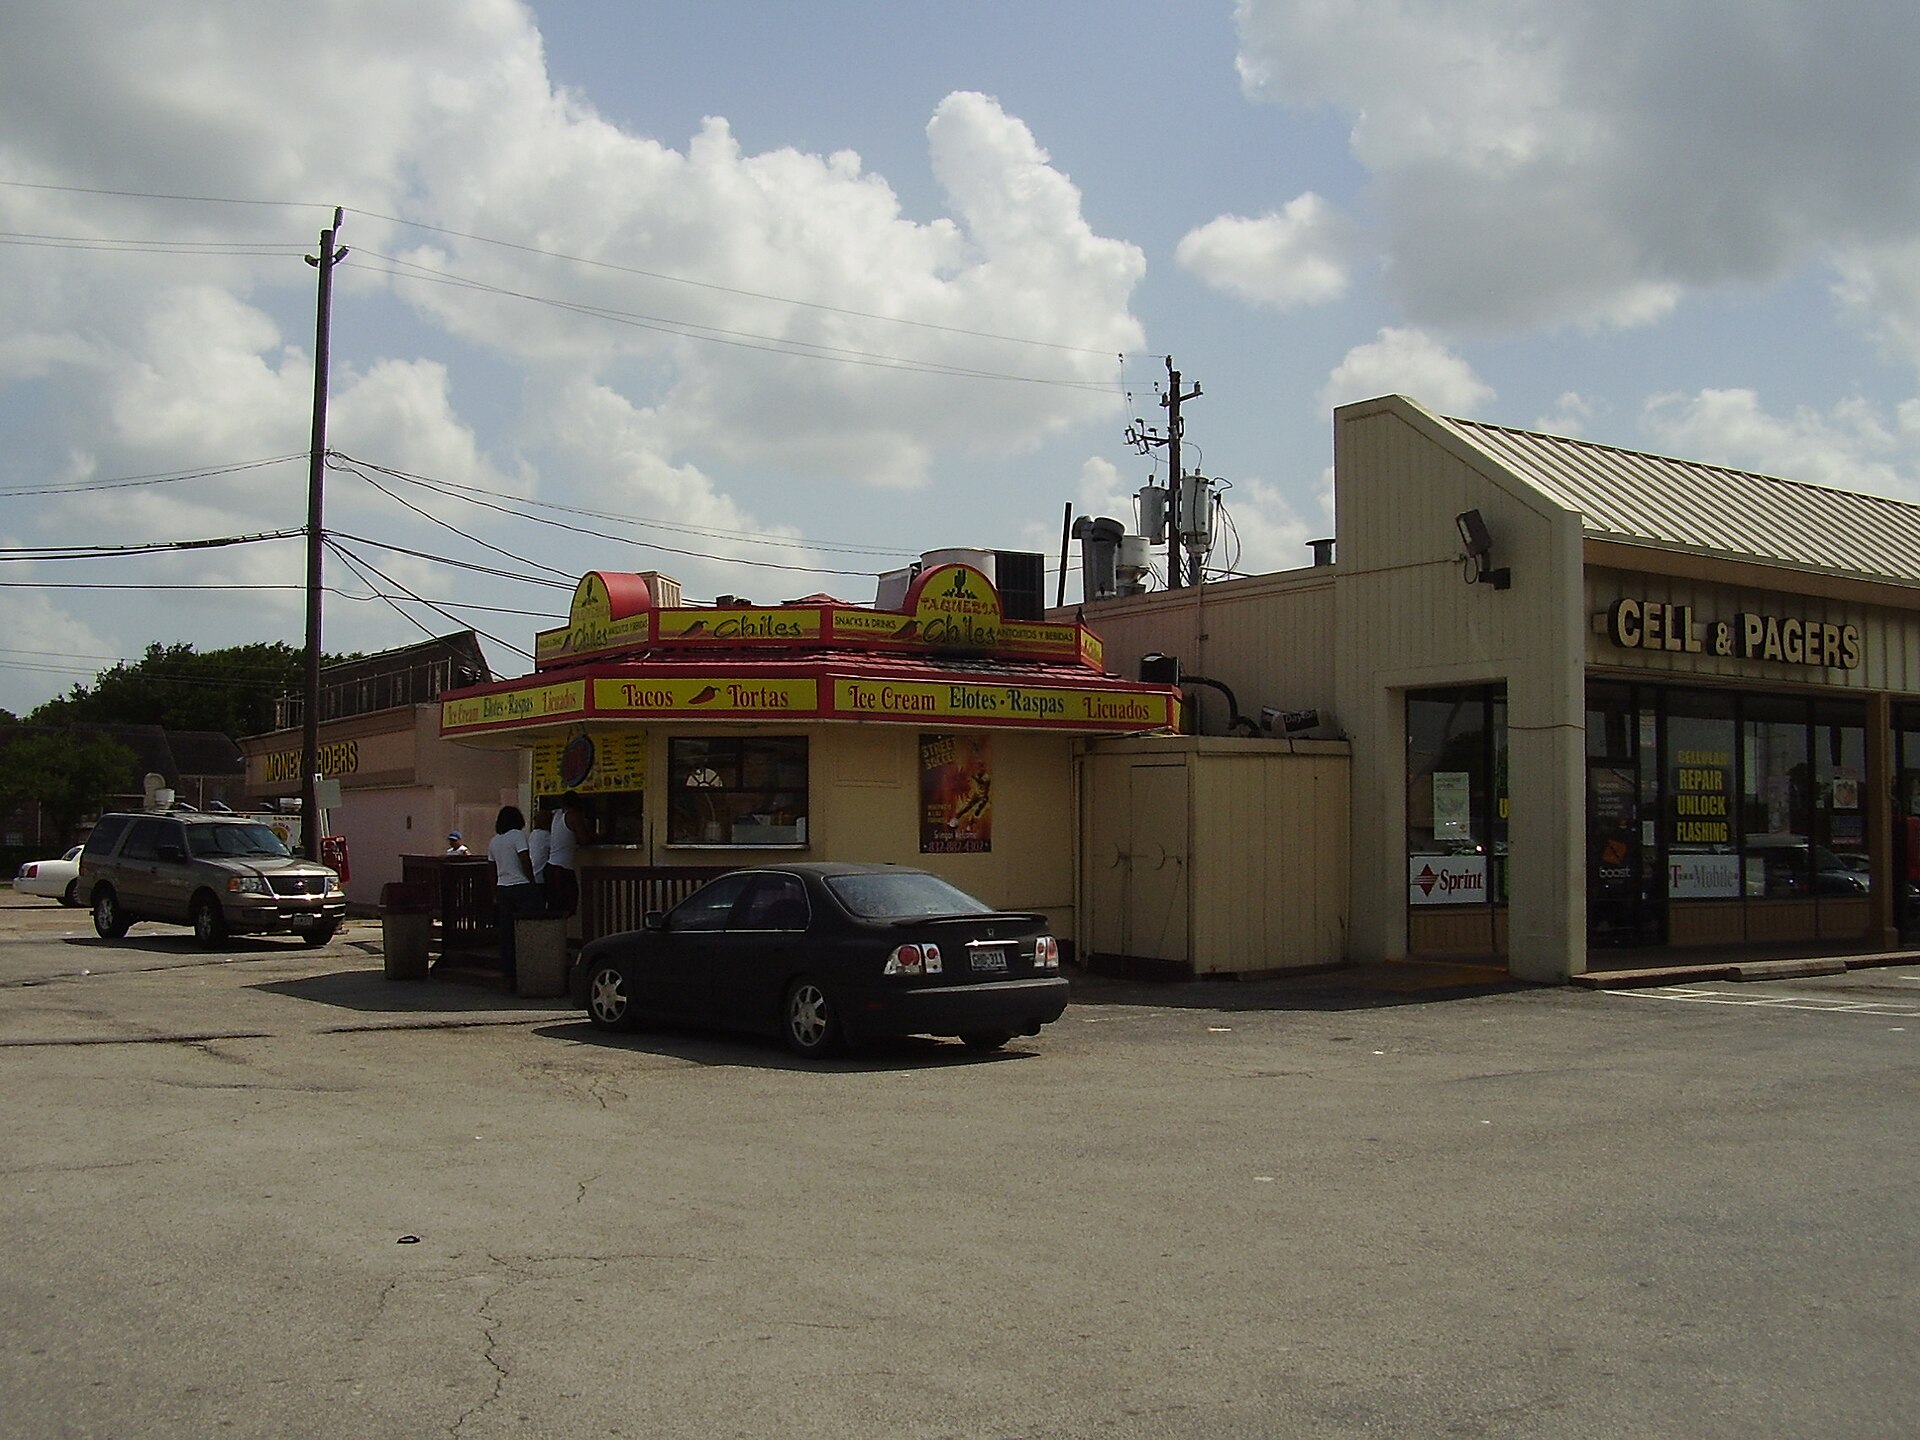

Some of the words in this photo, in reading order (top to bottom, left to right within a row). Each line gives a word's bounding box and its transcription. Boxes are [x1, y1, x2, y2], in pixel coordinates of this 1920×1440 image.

[920, 597, 1000, 615] TAQUERIA
[713, 615, 802, 638] Chiles
[834, 616, 863, 628] SNACKS
[871, 618, 897, 629] DRINKS
[922, 614, 998, 646] Chiles
[1610, 597, 1702, 653] CELL
[1710, 621, 1733, 656] &
[1737, 612, 1861, 669] PAGERS
[1038, 630, 1044, 640] Y
[1045, 631, 1074, 642] BEBIDAS
[621, 684, 674, 707] Tacos
[727, 684, 789, 708] Tortas
[848, 686, 876, 709] Ice
[881, 687, 936, 711] Cream
[949, 686, 997, 710] Elotes
[1007, 689, 1065, 717] Raspas
[1082, 693, 1150, 720] Licuados
[264, 750, 304, 782] MONEY
[317, 740, 358, 777] RDERS
[1679, 769, 1722, 790] REPAIR
[1677, 795, 1726, 816] UNLOCK
[1677, 821, 1728, 842] FLASHING
[1440, 869, 1482, 894] Sprint
[1599, 865, 1631, 878] boost
